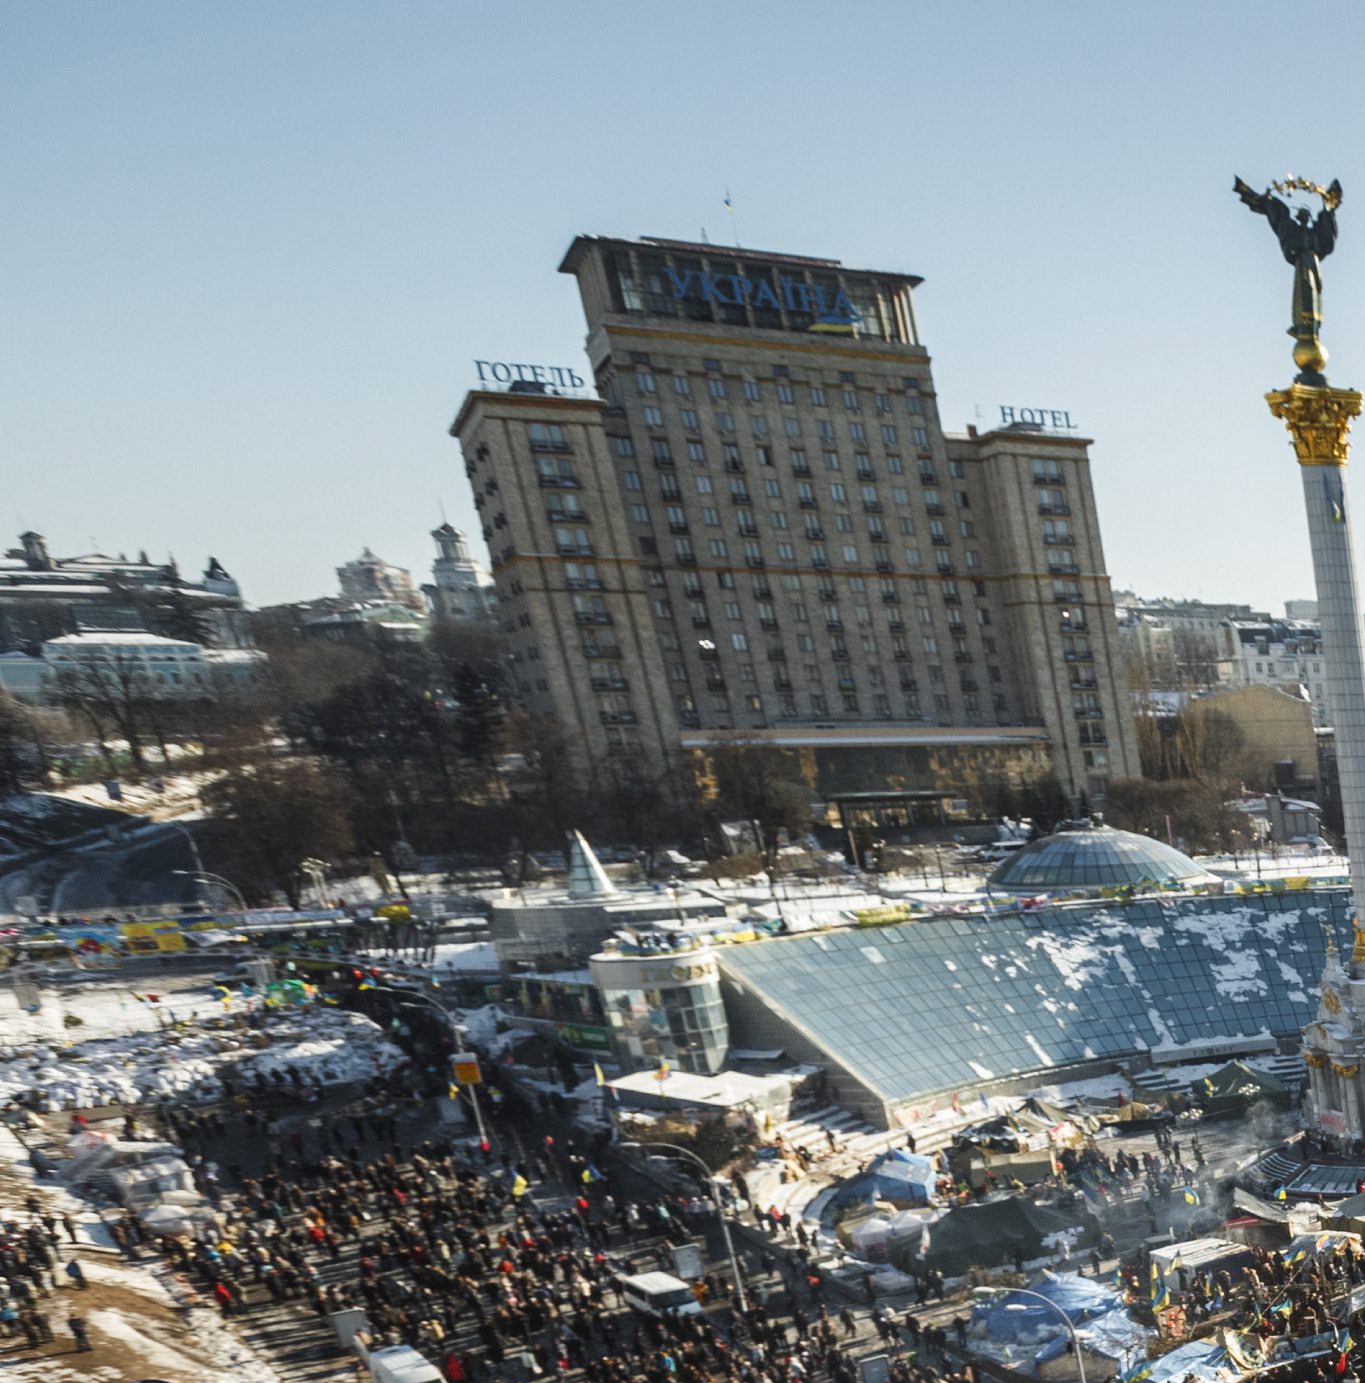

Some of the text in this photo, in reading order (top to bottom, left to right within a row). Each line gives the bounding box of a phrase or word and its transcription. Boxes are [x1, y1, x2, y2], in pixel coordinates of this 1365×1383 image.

[664, 266, 862, 320] УКРАЇНА
[472, 360, 585, 388] ГОТЕЛЬ
[999, 405, 1078, 429] HOTEL
